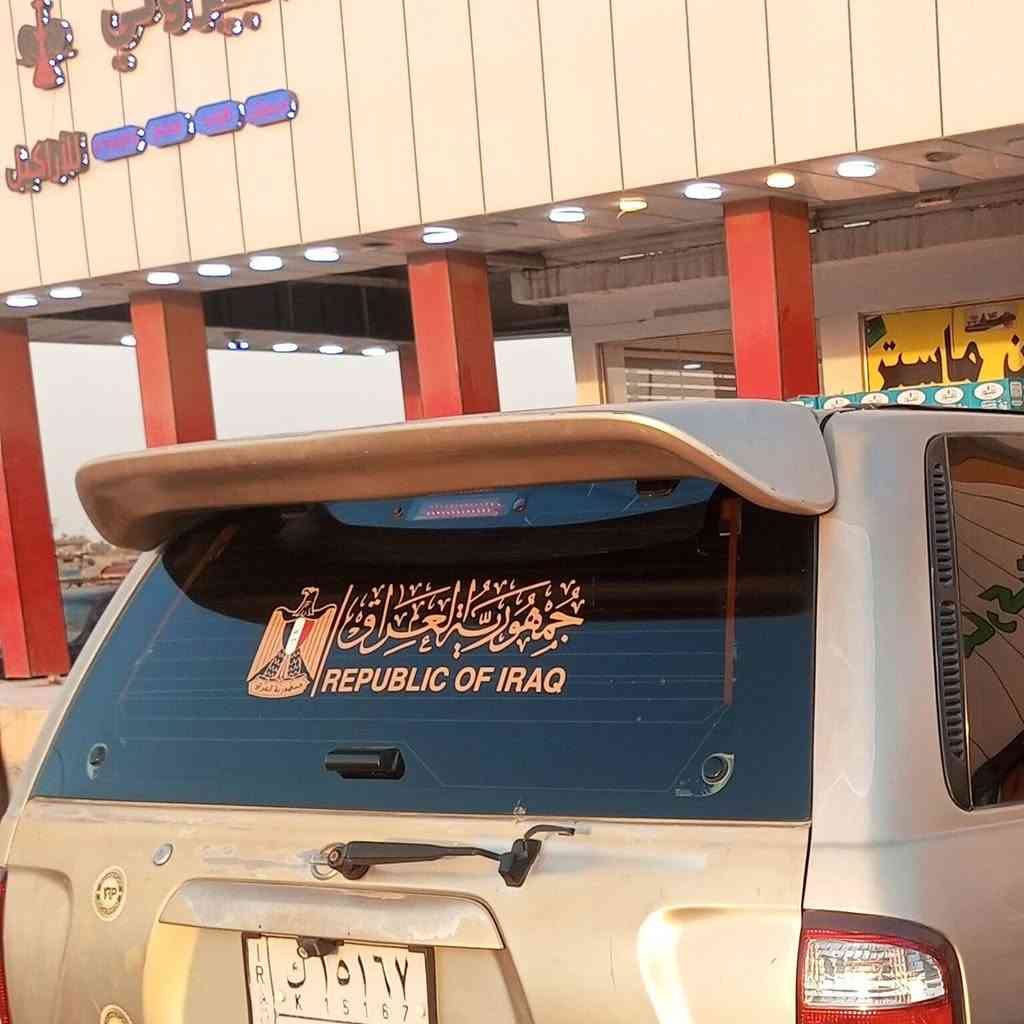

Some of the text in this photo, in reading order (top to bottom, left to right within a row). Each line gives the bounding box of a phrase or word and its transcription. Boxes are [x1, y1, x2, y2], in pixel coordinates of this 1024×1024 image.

[321, 666, 567, 695] REPUBLIC OF IRAQ
